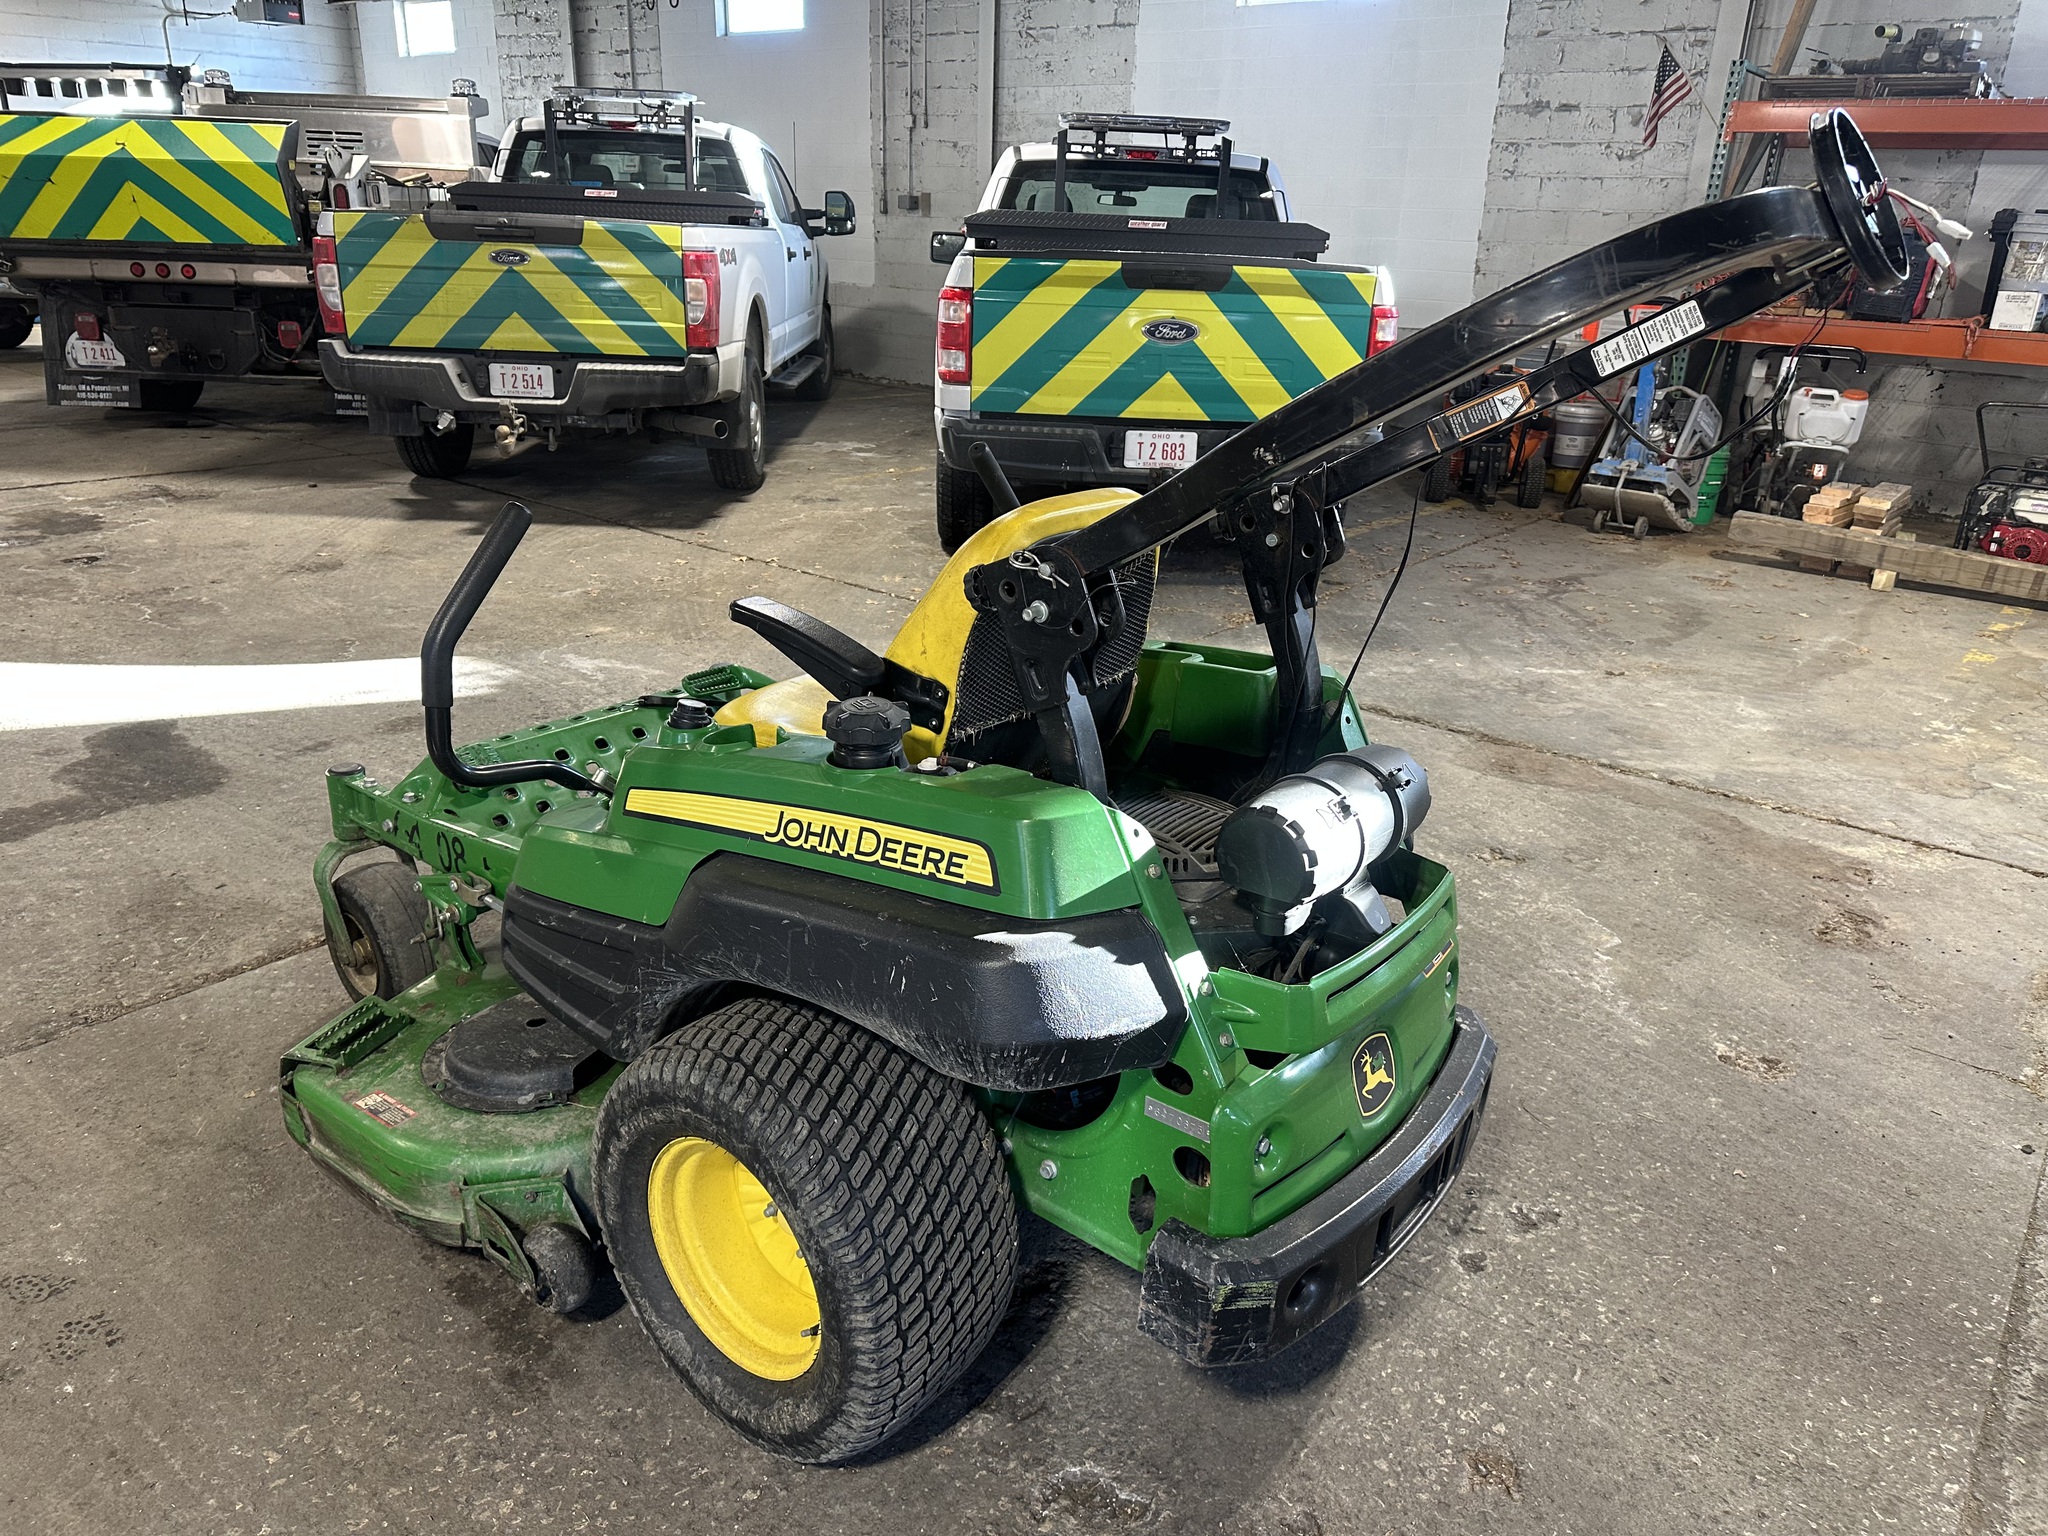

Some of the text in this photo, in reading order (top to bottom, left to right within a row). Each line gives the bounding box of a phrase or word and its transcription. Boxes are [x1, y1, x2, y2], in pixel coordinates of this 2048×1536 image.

[556, 111, 594, 120] BCK
[1070, 144, 1116, 155] BAK
[1172, 149, 1219, 158] RCK
[497, 251, 521, 263] Ford
[1155, 323, 1187, 340] Ford
[82, 347, 117, 360] T 2 411
[500, 373, 543, 390] T 2 514
[1137, 442, 1186, 461] T 2 683
[765, 810, 969, 879] JOHN DEERE
